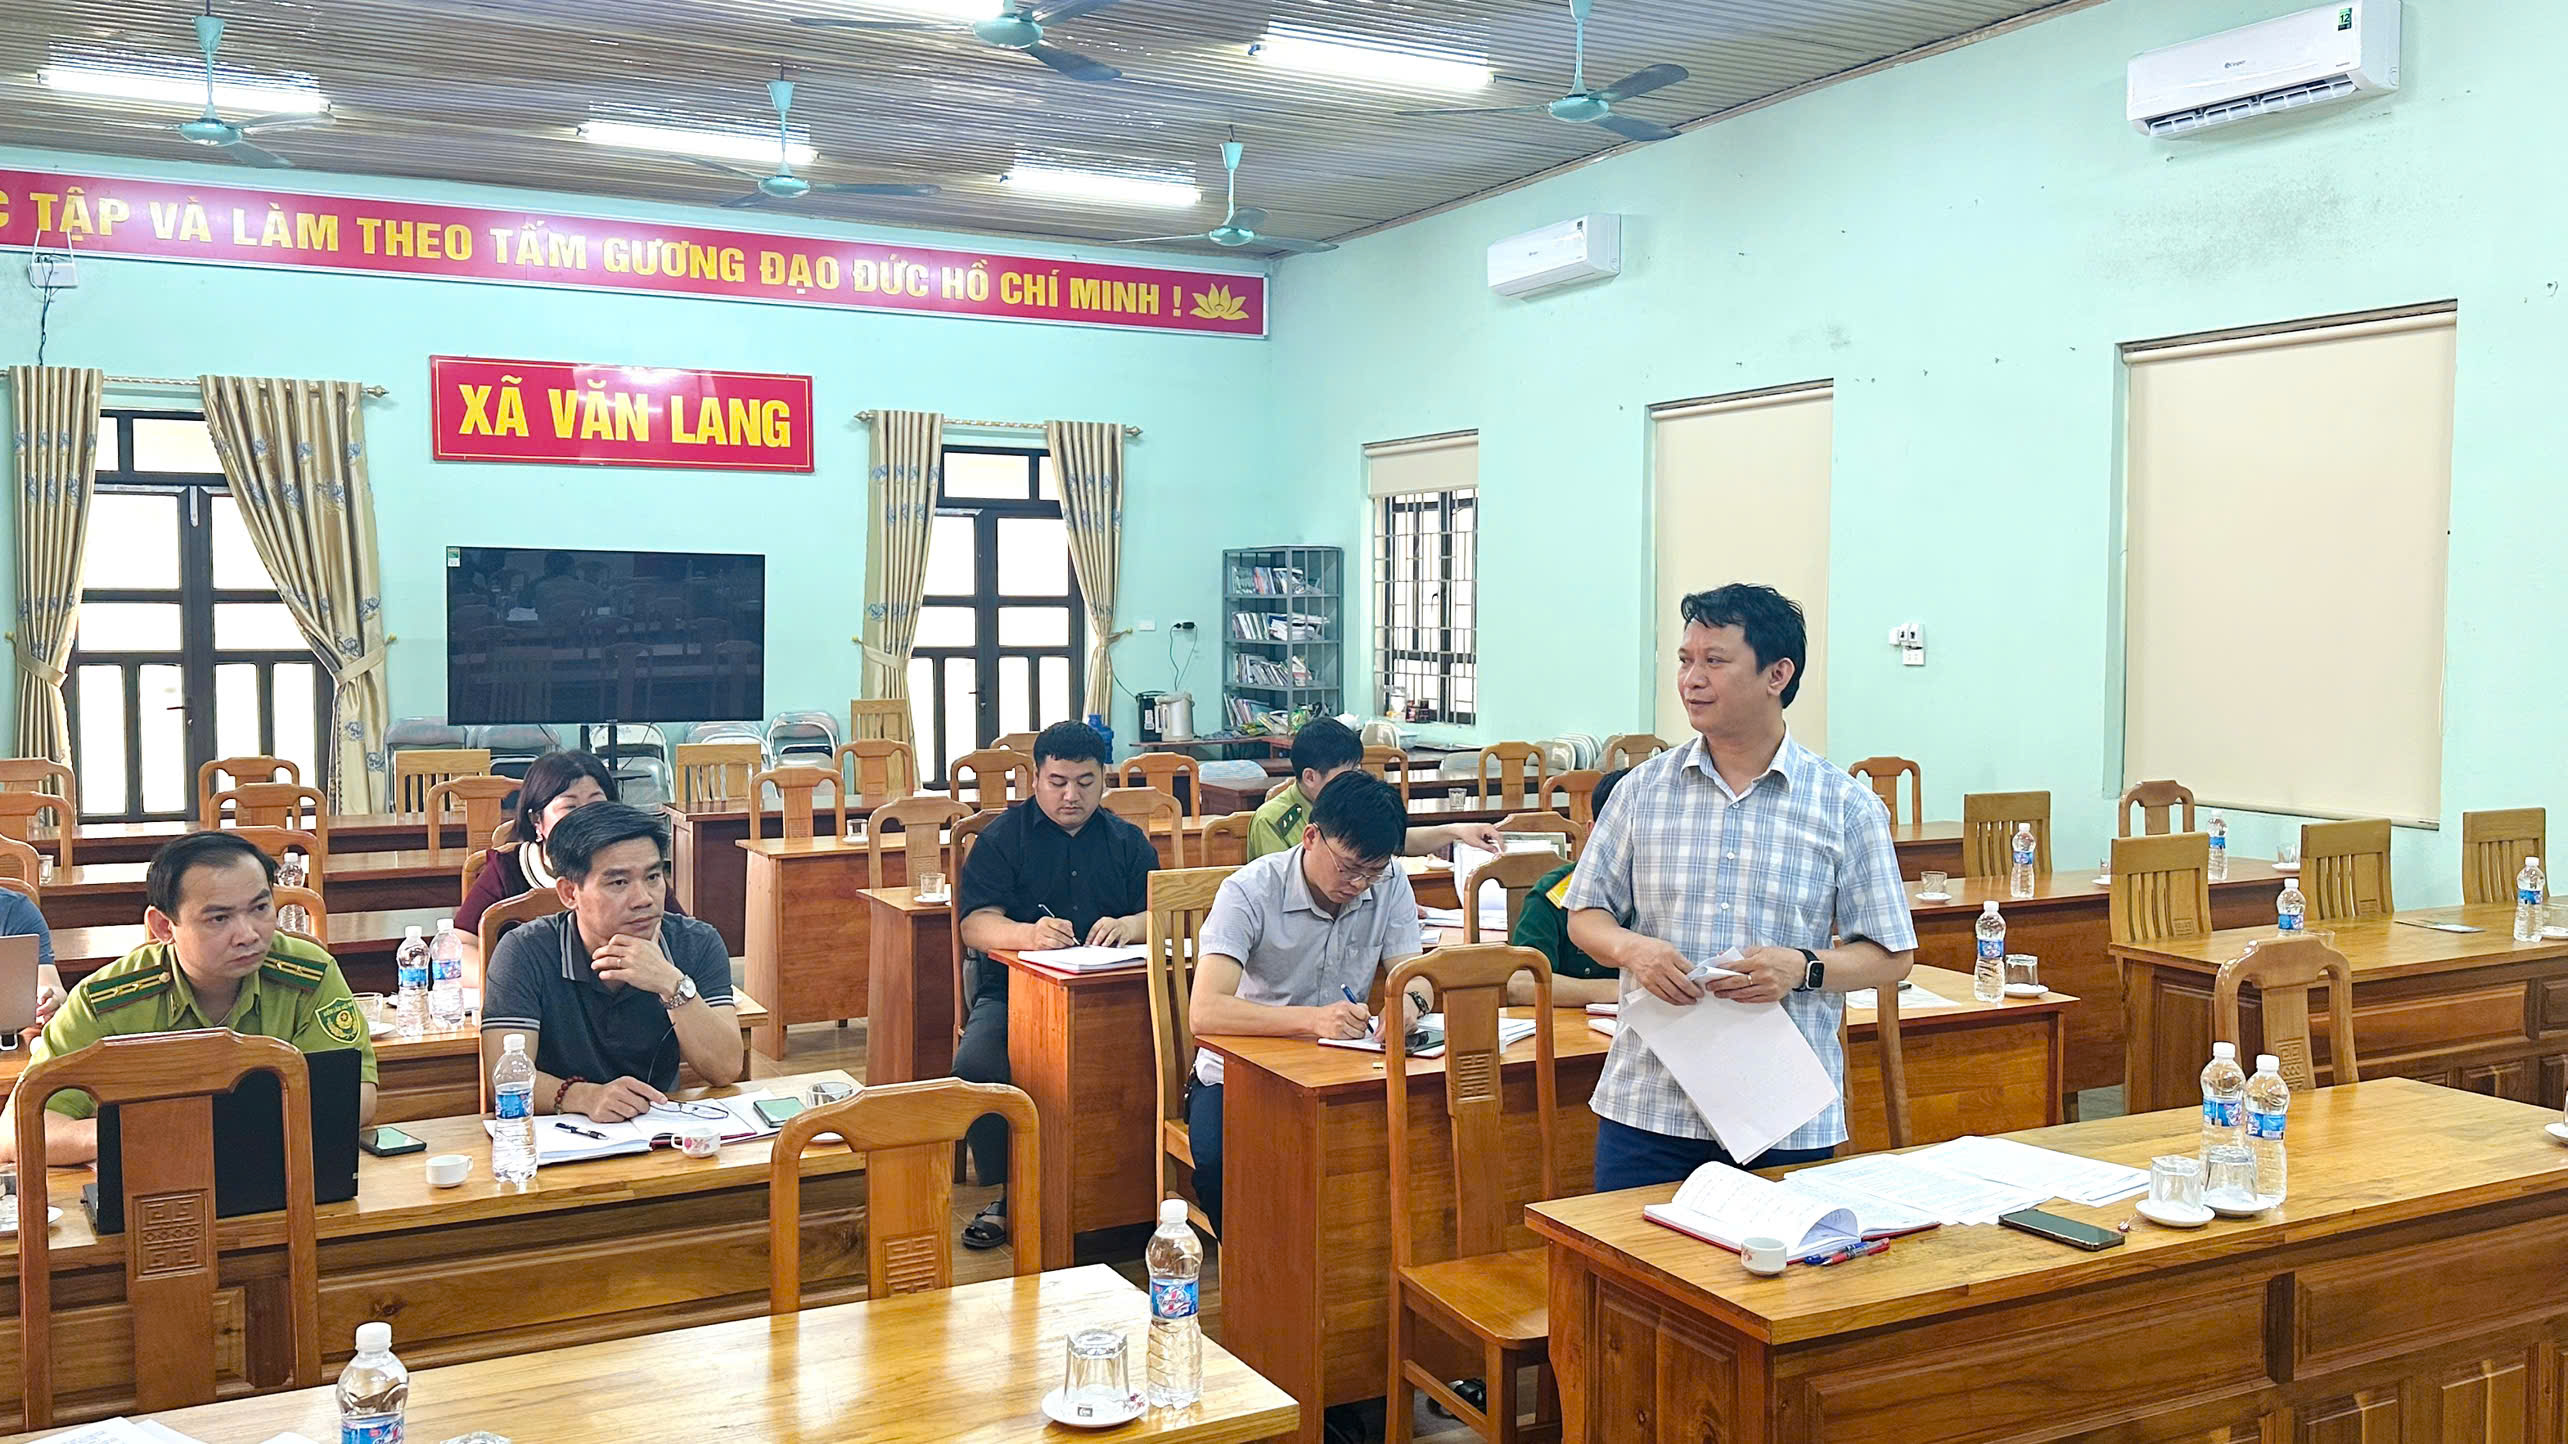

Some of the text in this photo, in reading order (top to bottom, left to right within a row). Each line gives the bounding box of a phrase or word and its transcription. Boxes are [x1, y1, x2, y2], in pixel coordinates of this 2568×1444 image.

[2340, 13, 2350, 24] 12
[30, 186, 129, 241] TẬP
[148, 196, 212, 243] VÀ
[232, 201, 339, 251] LÀM
[357, 217, 473, 261] THEO
[490, 220, 587, 270] TẤM
[603, 237, 745, 283] GƯƠNG
[759, 250, 840, 295] ĐẠO
[852, 253, 929, 297] ĐỨC
[941, 258, 989, 302] HỒ
[1000, 269, 1060, 308] CHÍ
[1070, 277, 1159, 315] MINH
[1173, 285, 1181, 317] !
[458, 374, 791, 448] XÃ VĂN LANG
